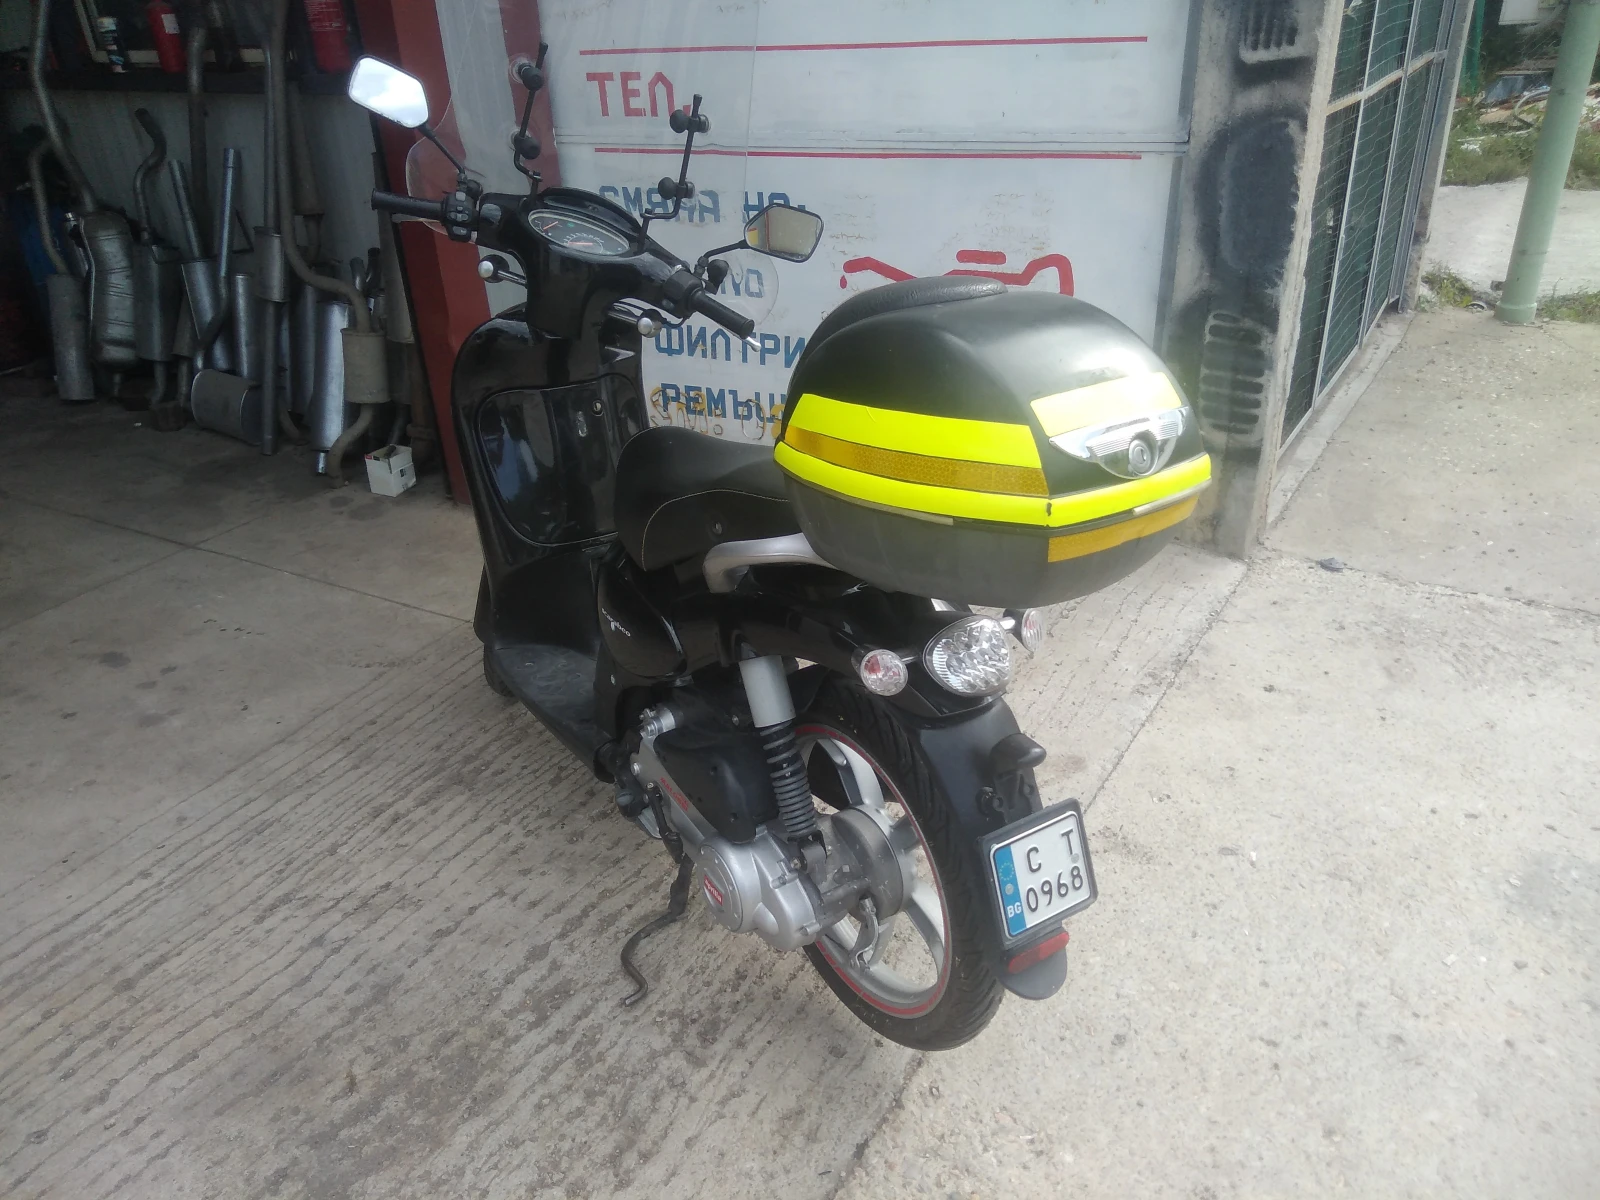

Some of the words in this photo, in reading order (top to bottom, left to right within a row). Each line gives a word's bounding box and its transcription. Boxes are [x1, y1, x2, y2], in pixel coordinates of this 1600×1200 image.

[655, 321, 805, 368] ФИЛТРИ
[661, 383, 787, 424] РЕМЪЦ
[1026, 846, 1042, 873] C
[1061, 828, 1074, 855] T
[1007, 902, 1022, 918] BG
[1026, 865, 1083, 912] 0968
